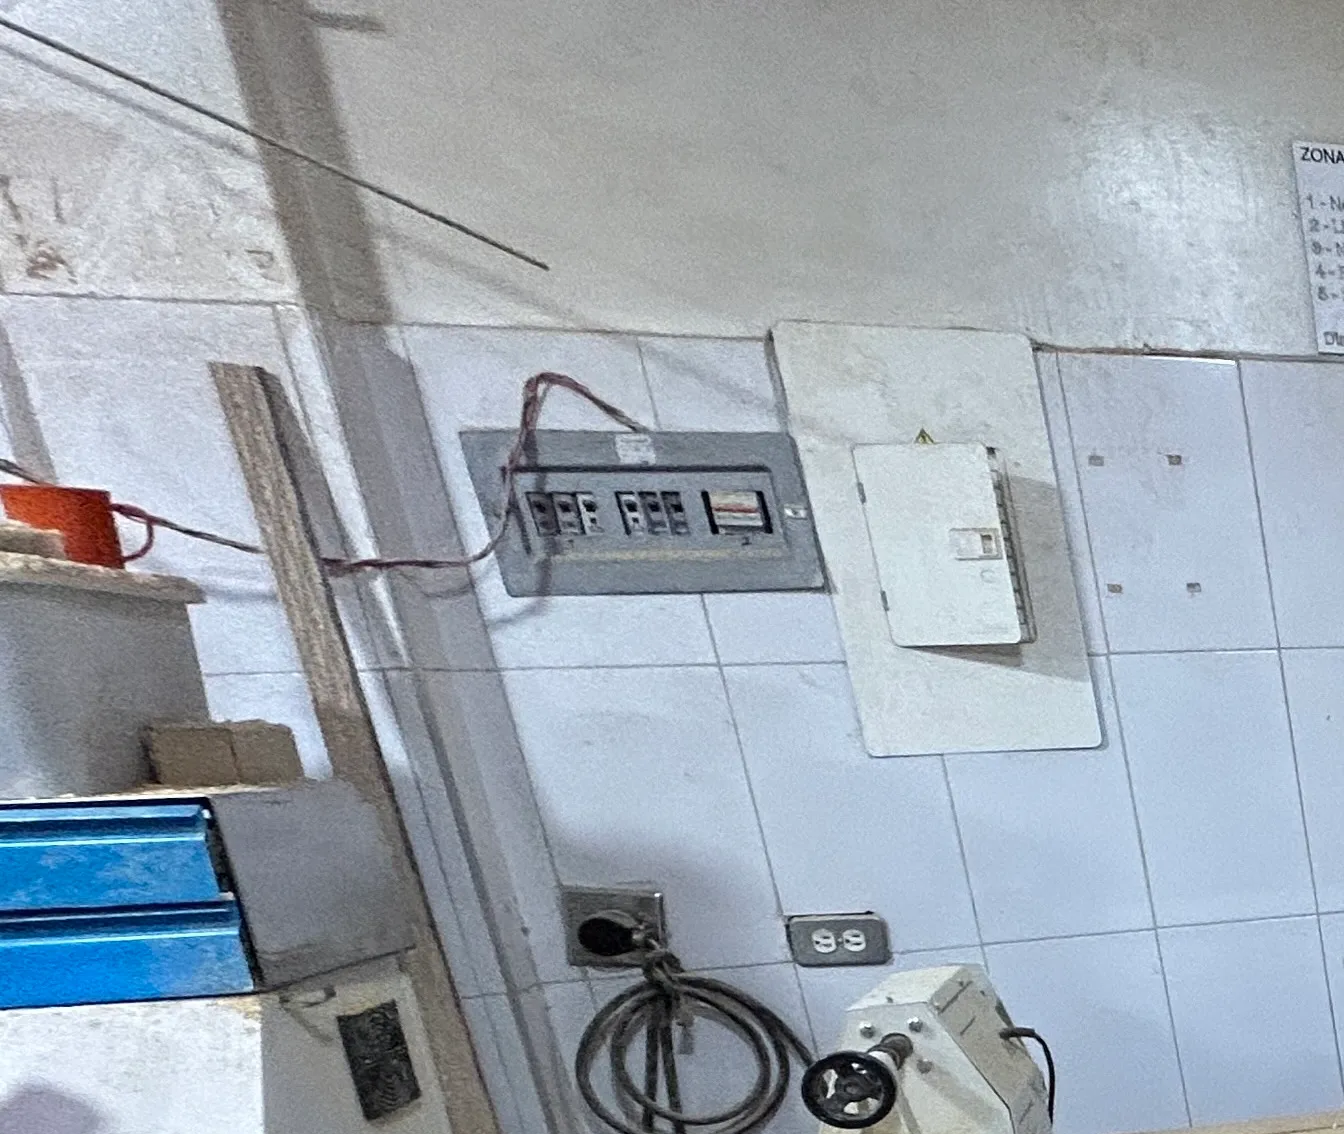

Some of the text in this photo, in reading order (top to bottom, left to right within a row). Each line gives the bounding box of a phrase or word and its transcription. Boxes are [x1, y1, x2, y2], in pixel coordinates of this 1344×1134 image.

[1306, 193, 1314, 209] 1
[1308, 217, 1319, 233] 2
[1315, 263, 1326, 280] 4
